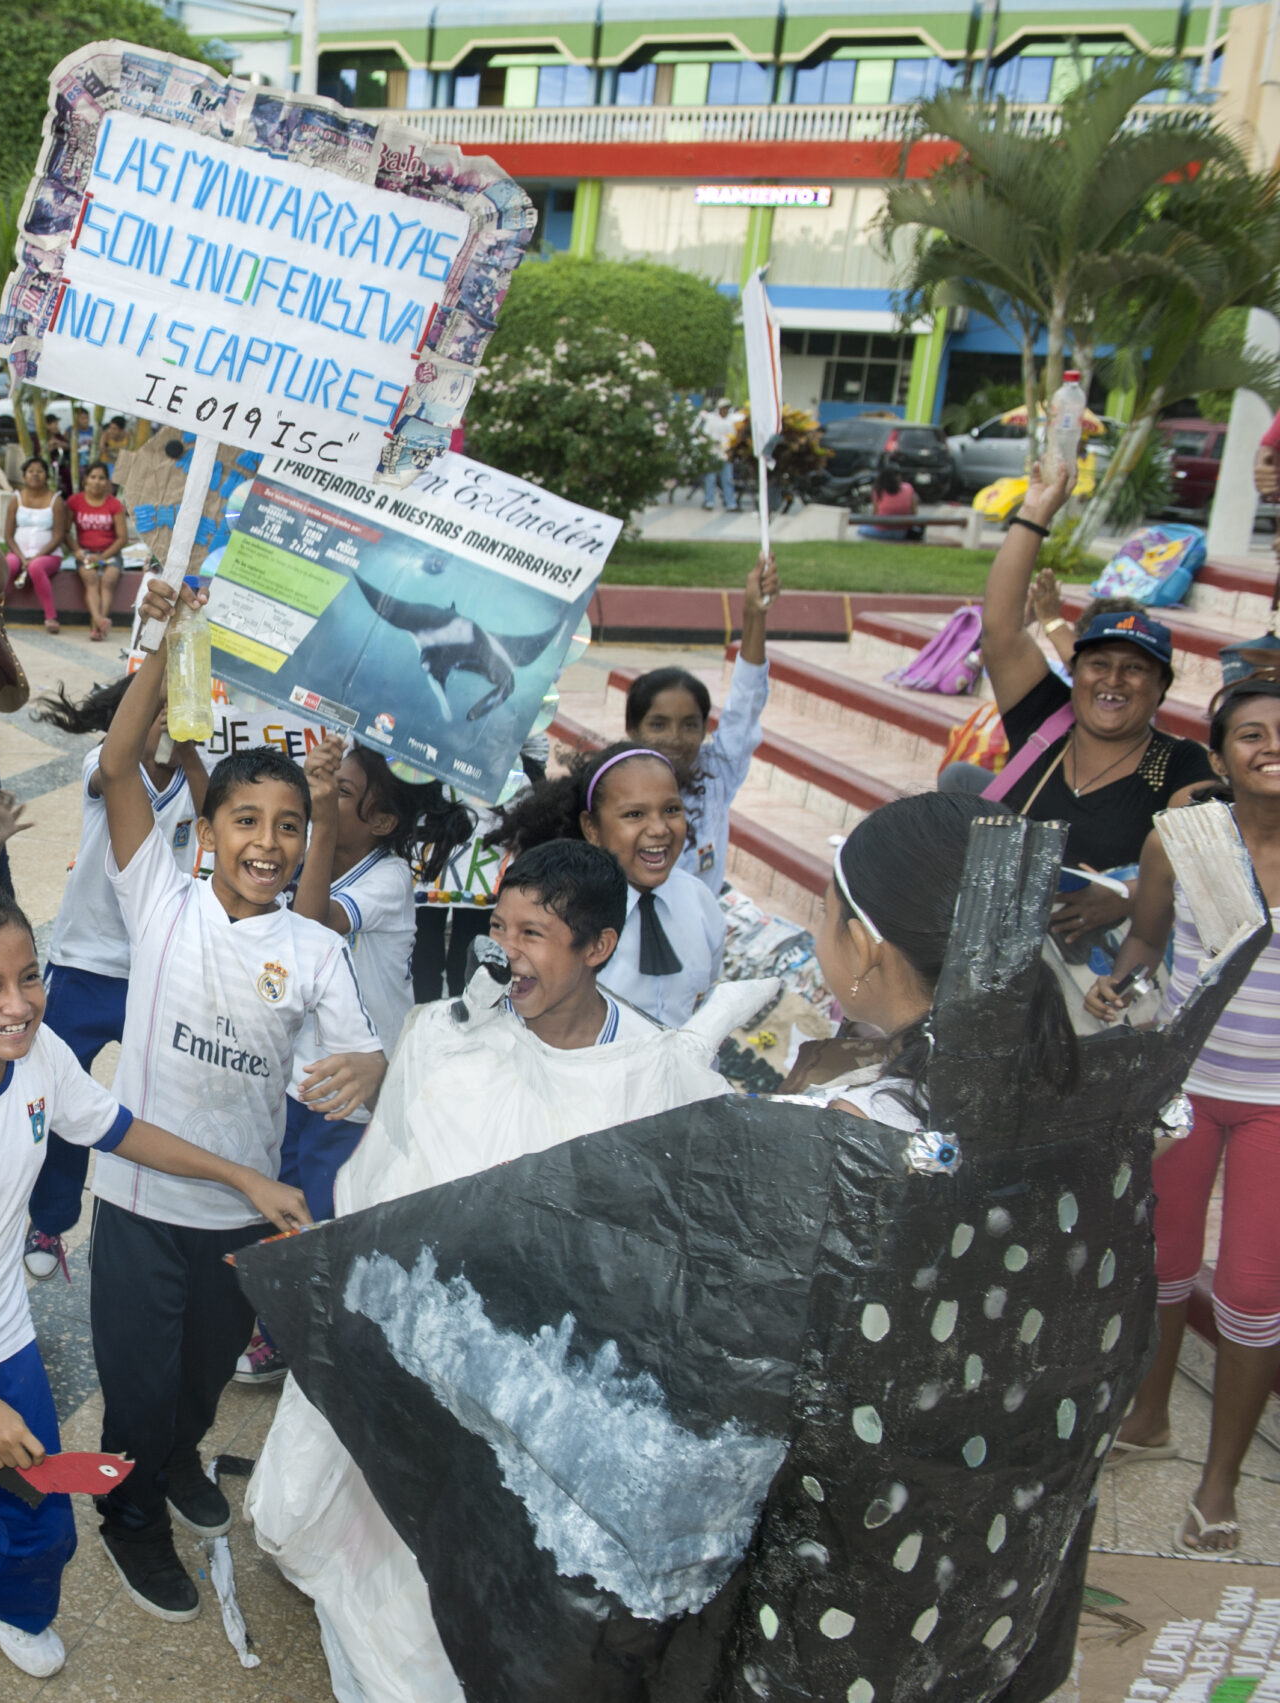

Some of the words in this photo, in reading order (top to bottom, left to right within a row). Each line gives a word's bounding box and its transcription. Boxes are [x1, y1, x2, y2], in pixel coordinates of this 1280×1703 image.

[93, 118, 175, 195] LAS
[171, 150, 464, 282] MANTARRAYAS
[196, 398, 262, 439] 019
[376, 495, 389, 510] A
[388, 500, 463, 539] NUESTRAS
[462, 529, 582, 588] MANTARRAYAS!
[454, 468, 605, 555] Extinción
[172, 1020, 271, 1078] Emirates
